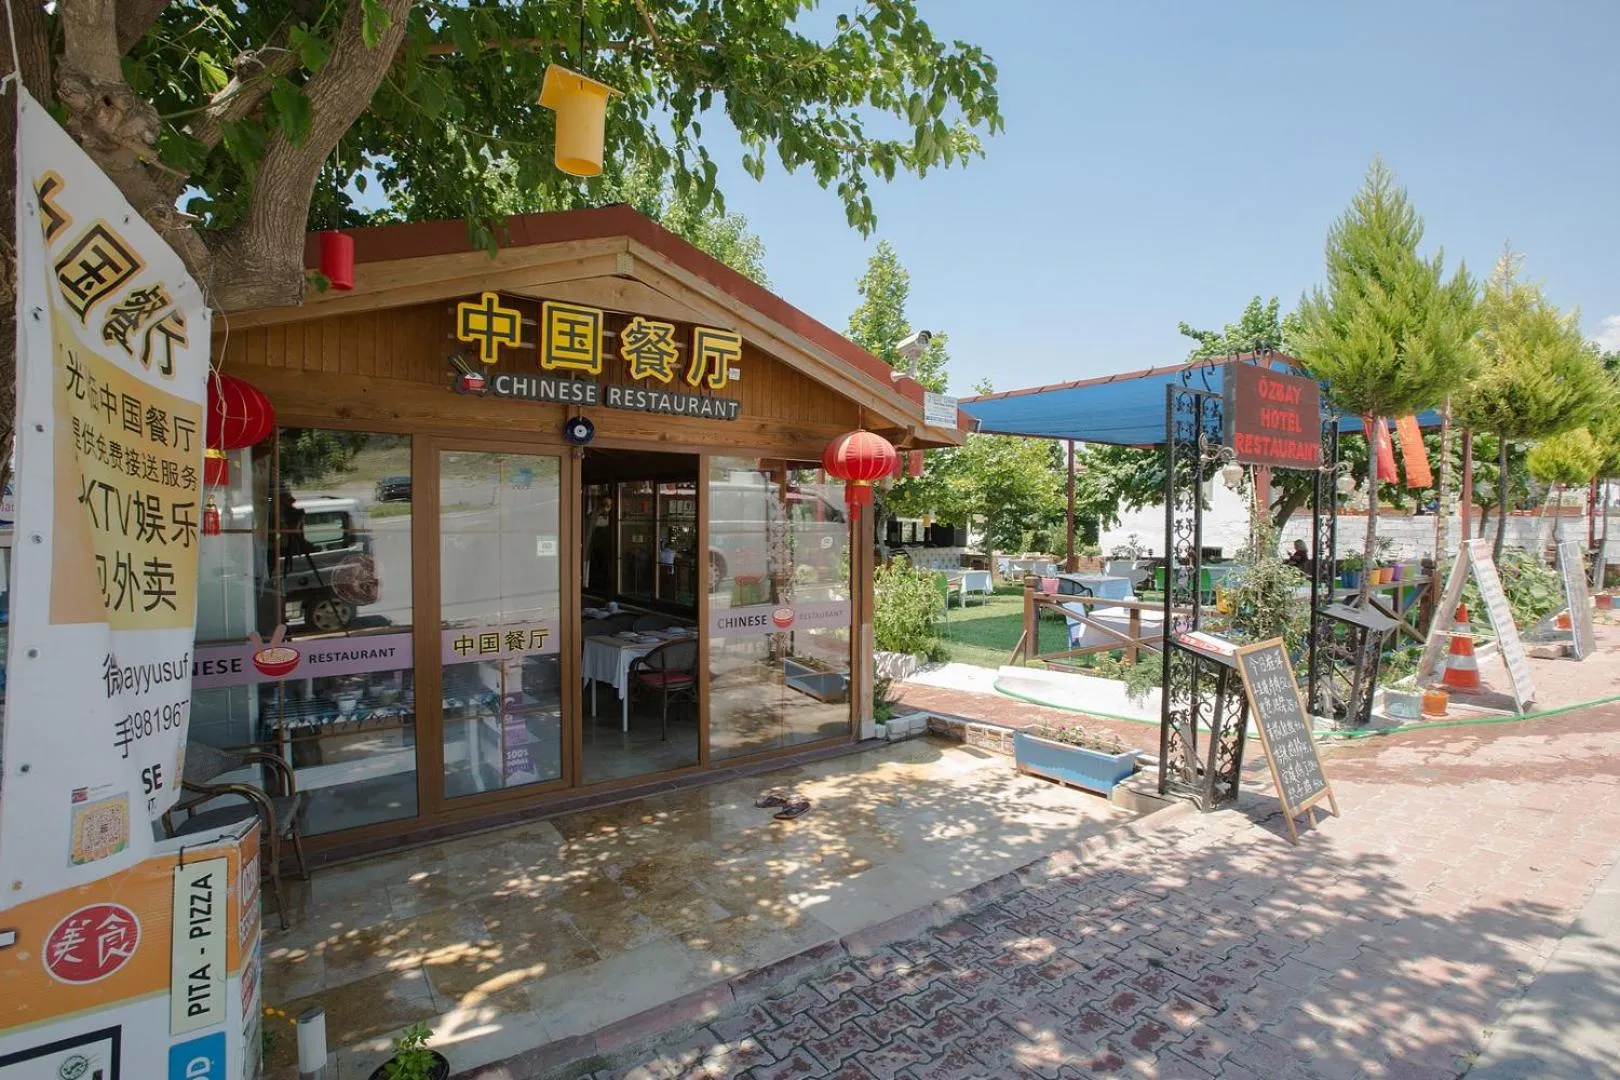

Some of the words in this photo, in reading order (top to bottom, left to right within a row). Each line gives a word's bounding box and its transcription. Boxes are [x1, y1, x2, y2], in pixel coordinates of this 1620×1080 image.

[457, 291, 742, 389] 中国餐厅
[496, 375, 597, 403] CHINESE
[609, 387, 739, 418] RESTAURANT
[1260, 407, 1302, 433] HOTEL
[1234, 432, 1320, 461] RESTAURANT
[717, 614, 768, 630] CHINESE
[308, 648, 396, 664] RESTAURANT
[453, 628, 549, 657] 中国餐厅
[189, 872, 213, 940] PIZZA
[50, 913, 132, 969] 美食
[187, 963, 212, 1017] PITA
